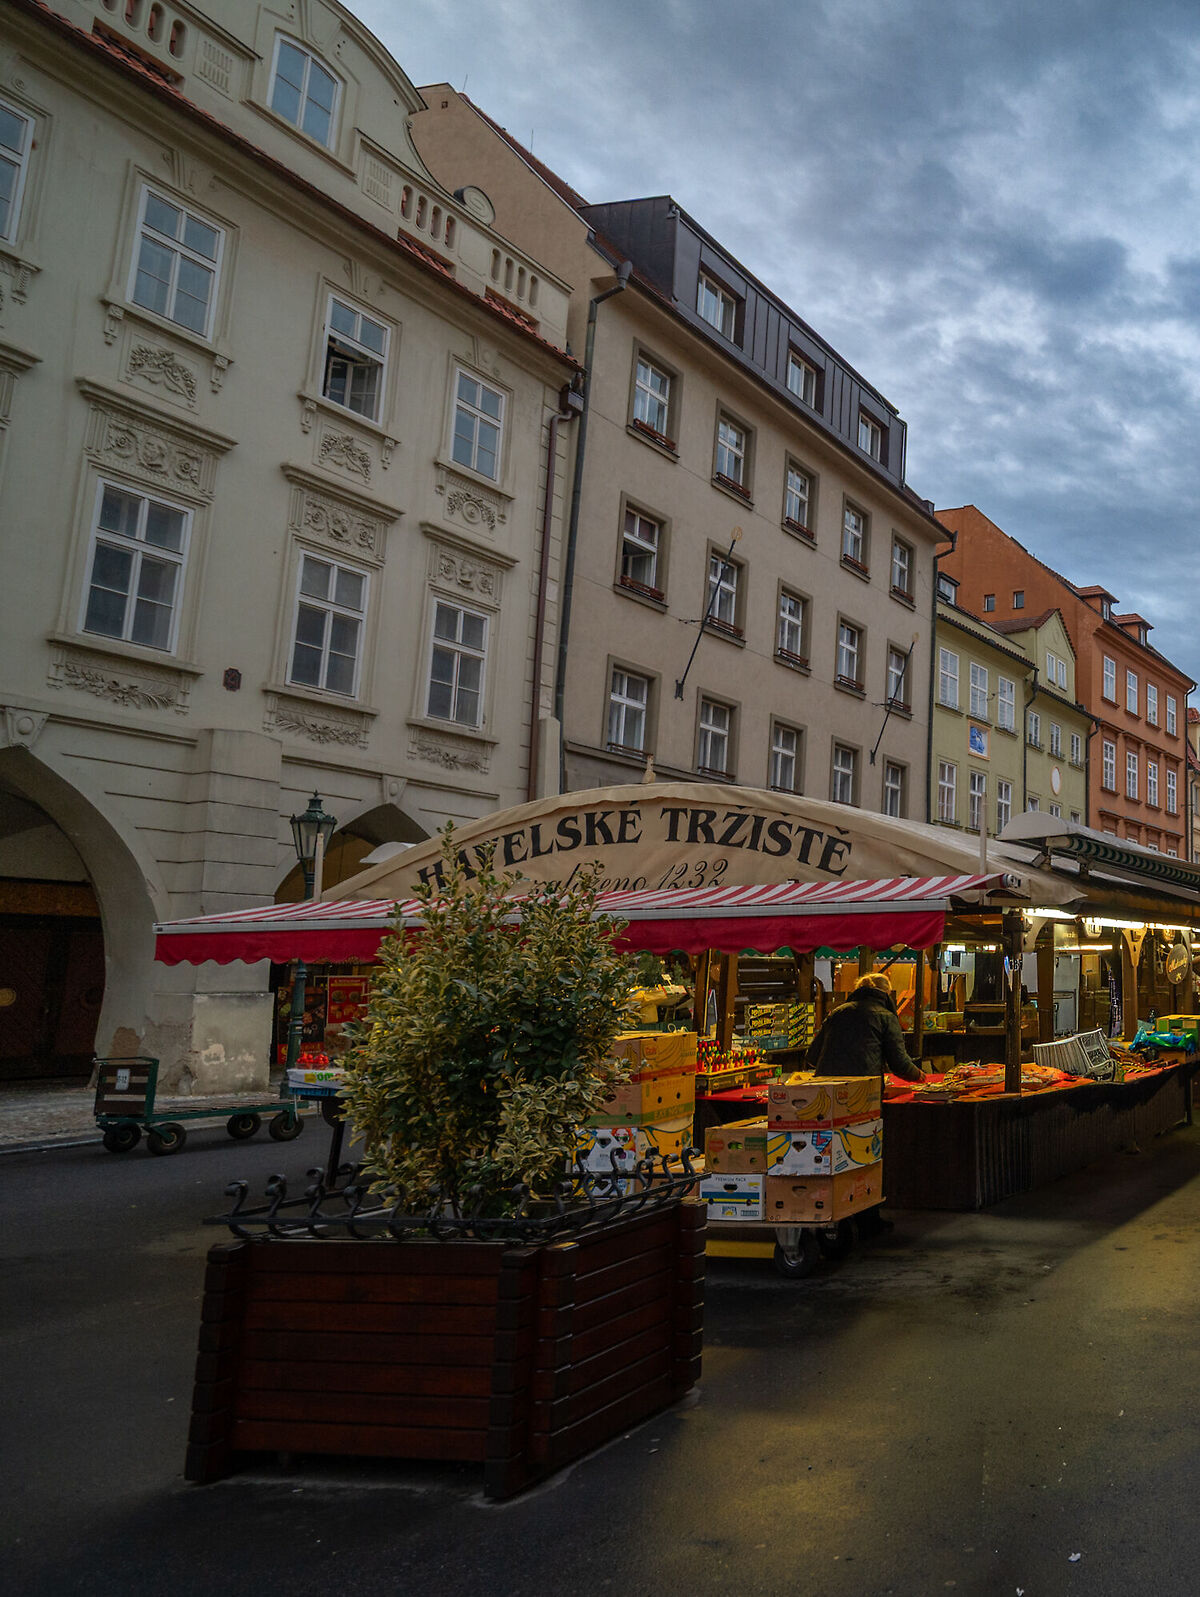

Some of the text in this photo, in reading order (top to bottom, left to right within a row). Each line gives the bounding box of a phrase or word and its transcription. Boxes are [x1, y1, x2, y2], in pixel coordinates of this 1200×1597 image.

[416, 800, 853, 897] HAVELSKÉ TRŽIŠTĚ
[528, 858, 729, 896] zaleno 1232
